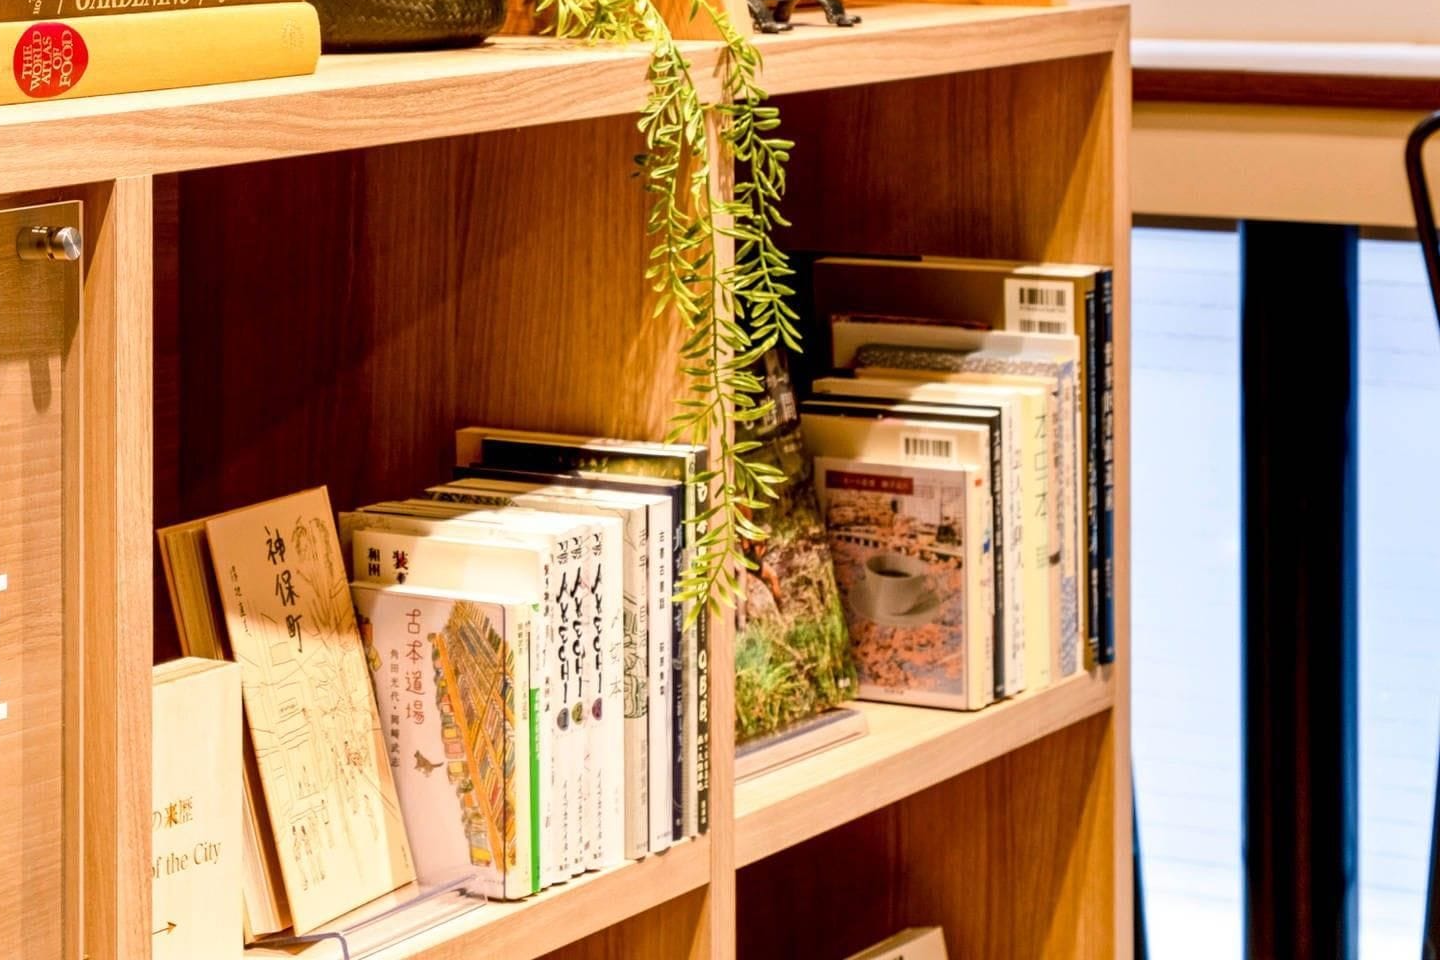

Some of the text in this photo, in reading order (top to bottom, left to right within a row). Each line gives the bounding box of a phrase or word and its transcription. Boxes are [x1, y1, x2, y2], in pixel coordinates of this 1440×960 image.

[22, 44, 33, 80] THE
[29, 30, 42, 91] WORLD
[41, 36, 52, 86] ATLAS
[52, 48, 63, 70] OF
[59, 30, 74, 87] FOOD
[264, 526, 303, 653] 神保町
[405, 608, 427, 726] 古本道場
[166, 852, 188, 876] the
[194, 840, 222, 865] City
